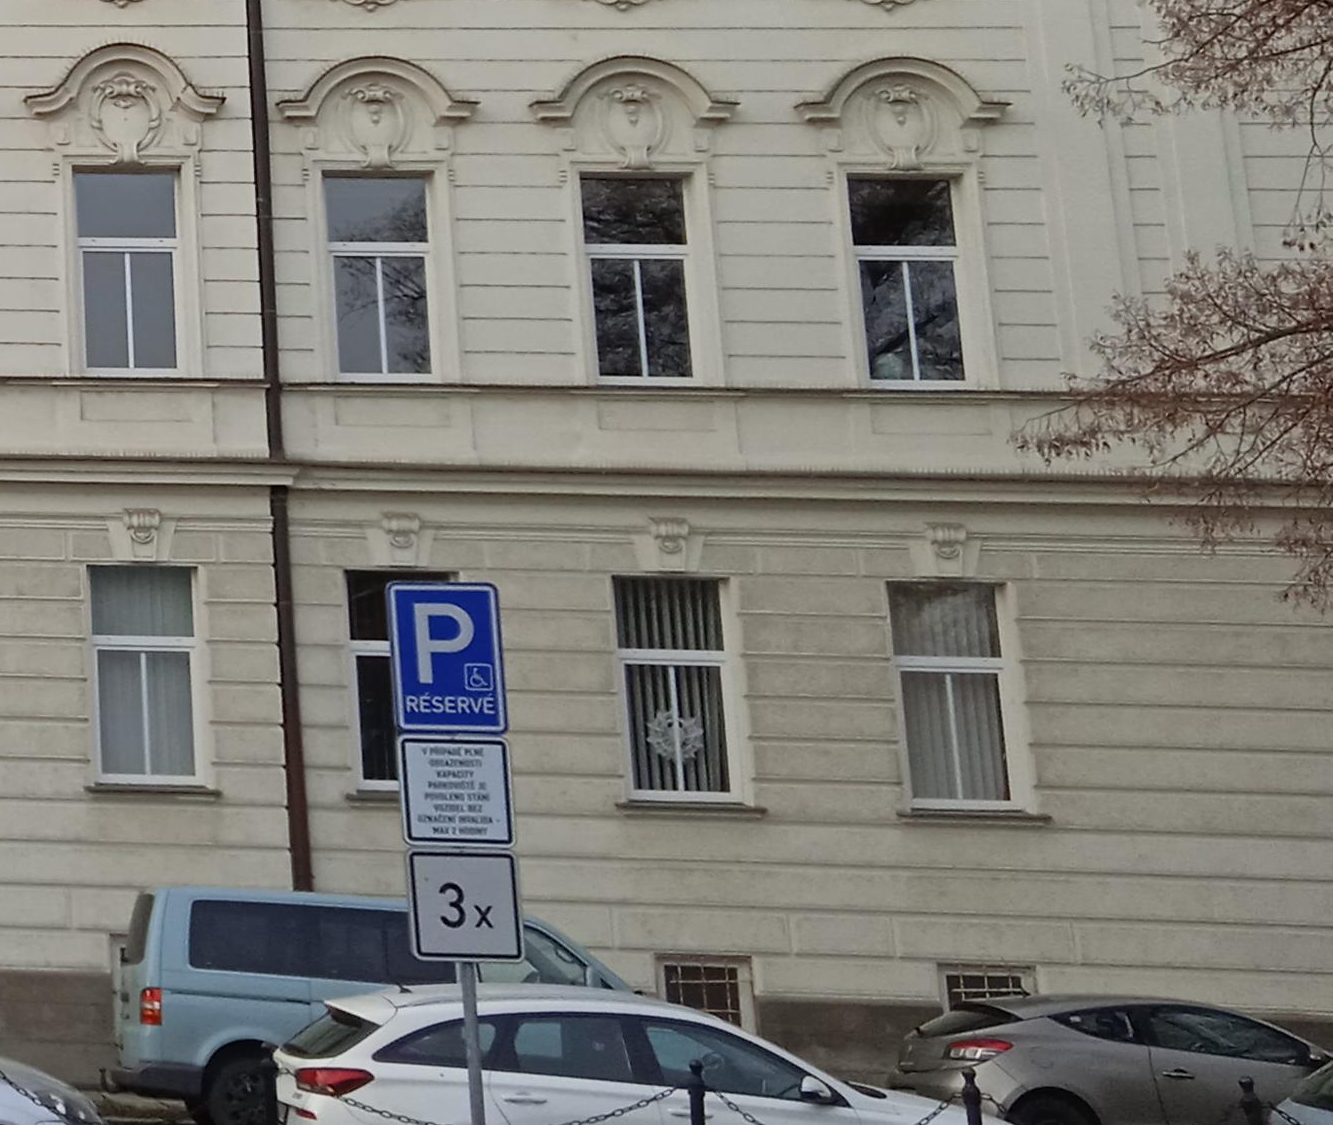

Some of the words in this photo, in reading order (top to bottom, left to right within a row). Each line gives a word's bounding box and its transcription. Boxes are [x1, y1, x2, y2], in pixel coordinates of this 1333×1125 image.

[414, 603, 474, 684] P
[405, 692, 496, 714] RÉSERVÉ
[436, 770, 474, 778] KAPACITY
[432, 827, 449, 835] MAX
